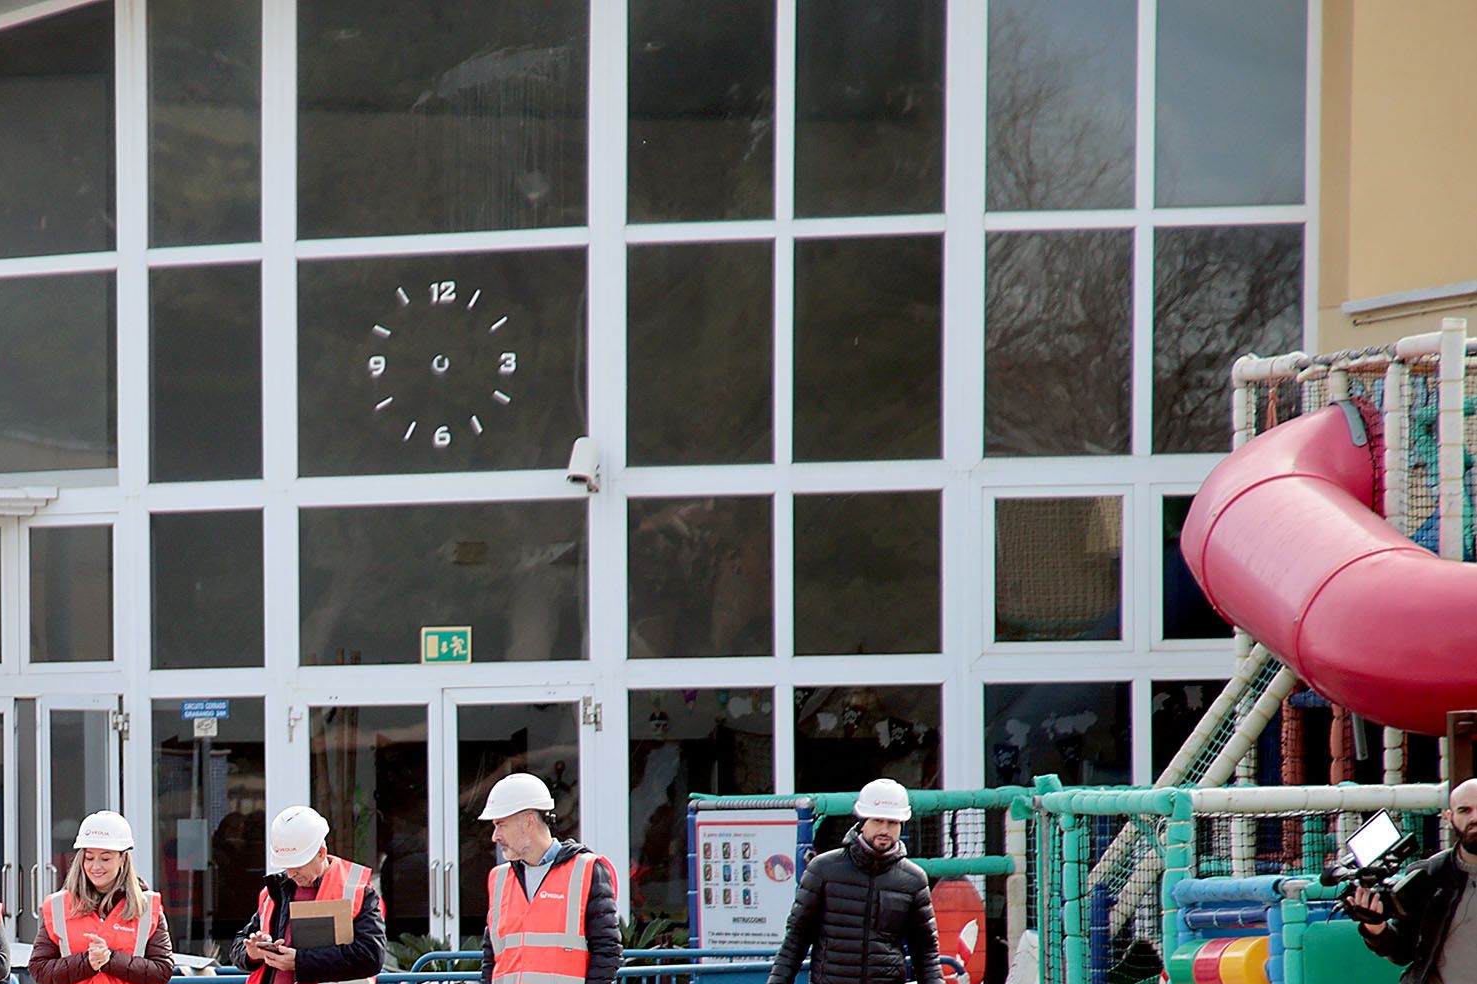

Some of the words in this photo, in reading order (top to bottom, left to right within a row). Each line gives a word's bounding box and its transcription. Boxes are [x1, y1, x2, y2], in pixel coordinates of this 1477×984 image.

[429, 280, 457, 303] 12
[368, 355, 386, 377] 9
[499, 352, 517, 374] 3
[433, 426, 451, 448] 6
